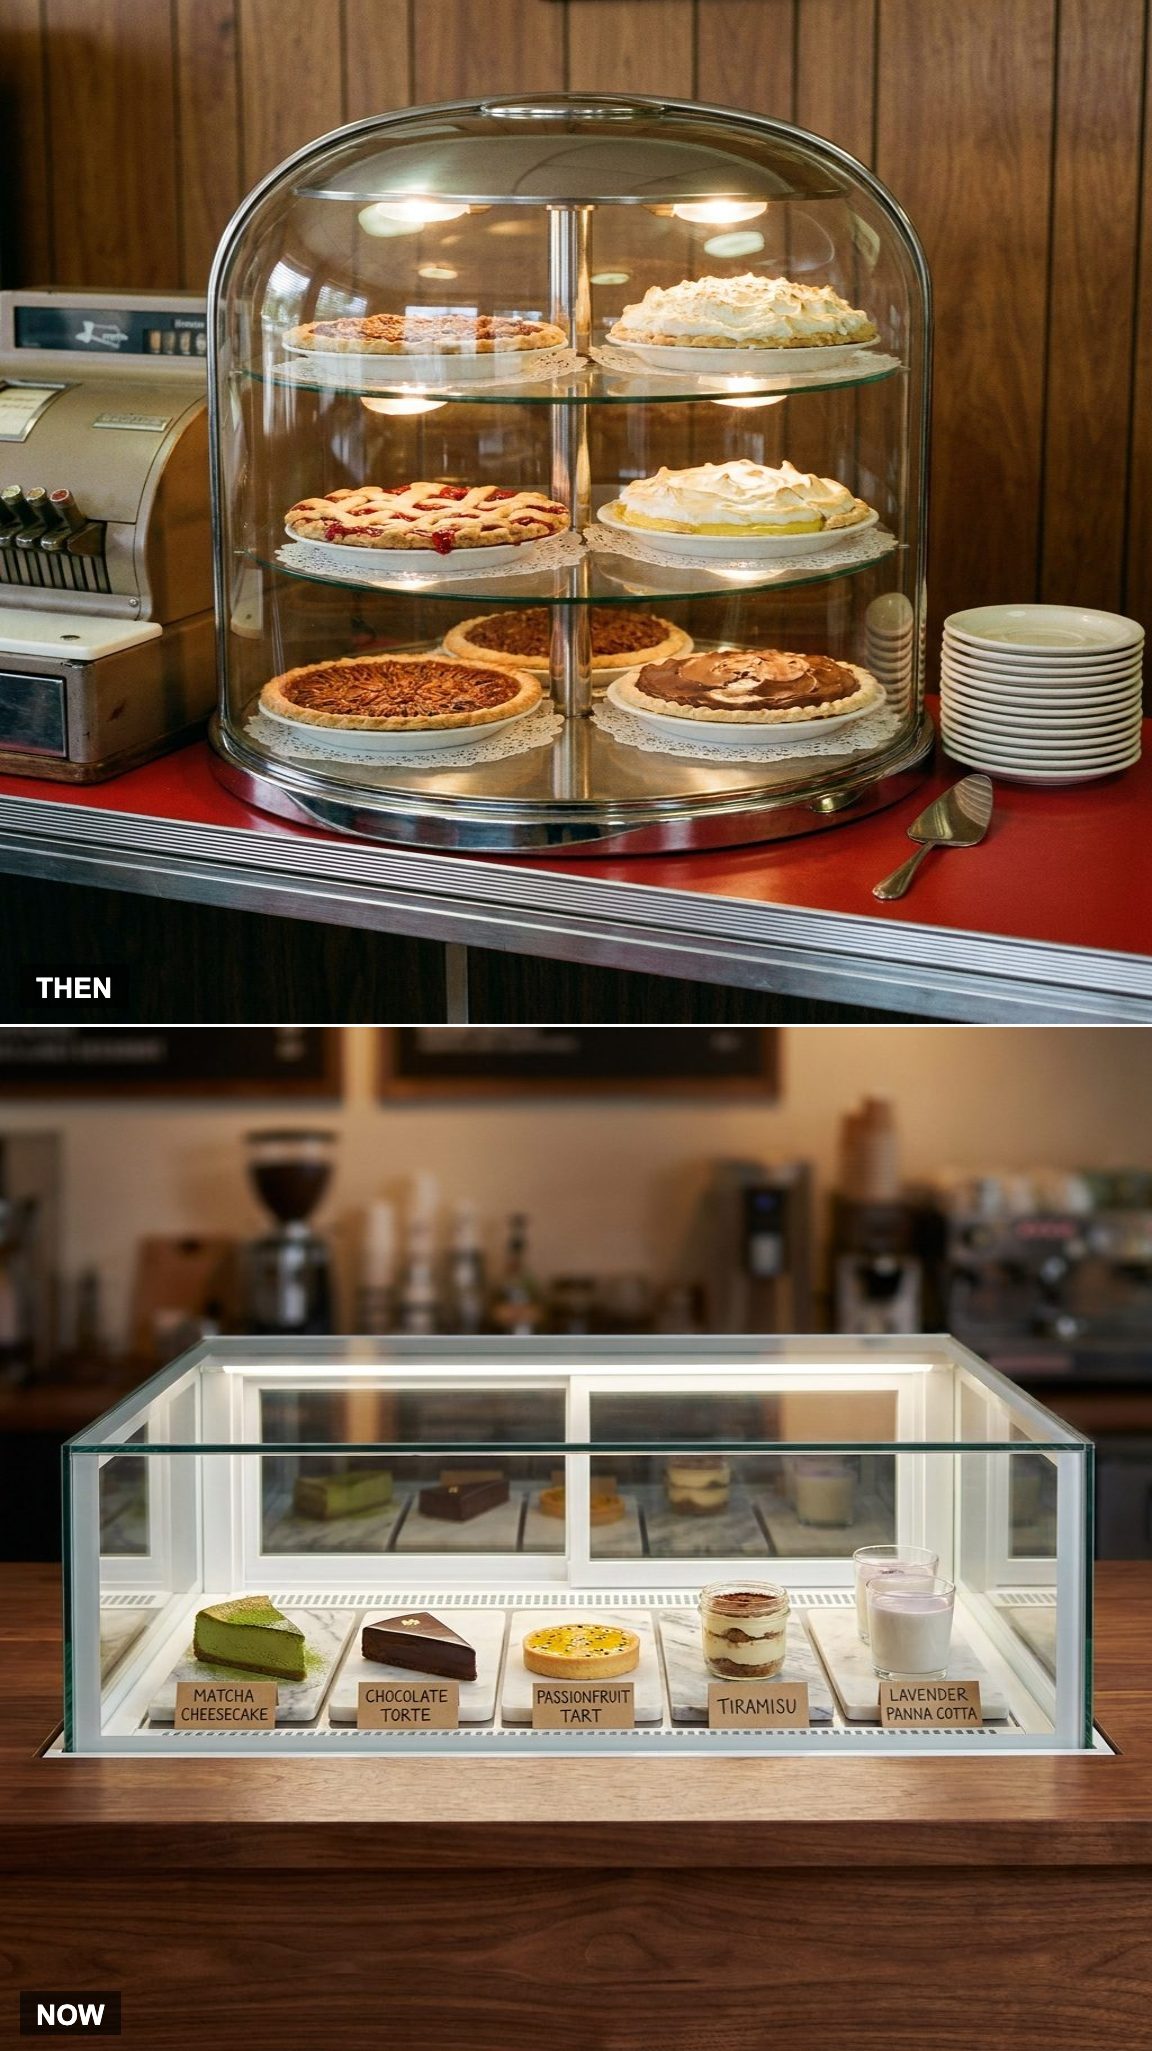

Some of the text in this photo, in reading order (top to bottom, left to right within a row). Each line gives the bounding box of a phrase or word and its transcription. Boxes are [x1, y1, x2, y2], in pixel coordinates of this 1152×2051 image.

[193, 1688, 255, 1703] MATCHA
[365, 1688, 448, 1704] CHOCOLATE
[537, 1689, 631, 1704] PASSIONFRUIT
[889, 1687, 969, 1702] LAVENDER
[717, 1697, 798, 1715] TIRAMISU
[886, 1706, 978, 1721] PANNA COTTA
[180, 1707, 269, 1722] CHEESECAKE
[379, 1707, 432, 1722] TORTE
[560, 1708, 602, 1723] TART
